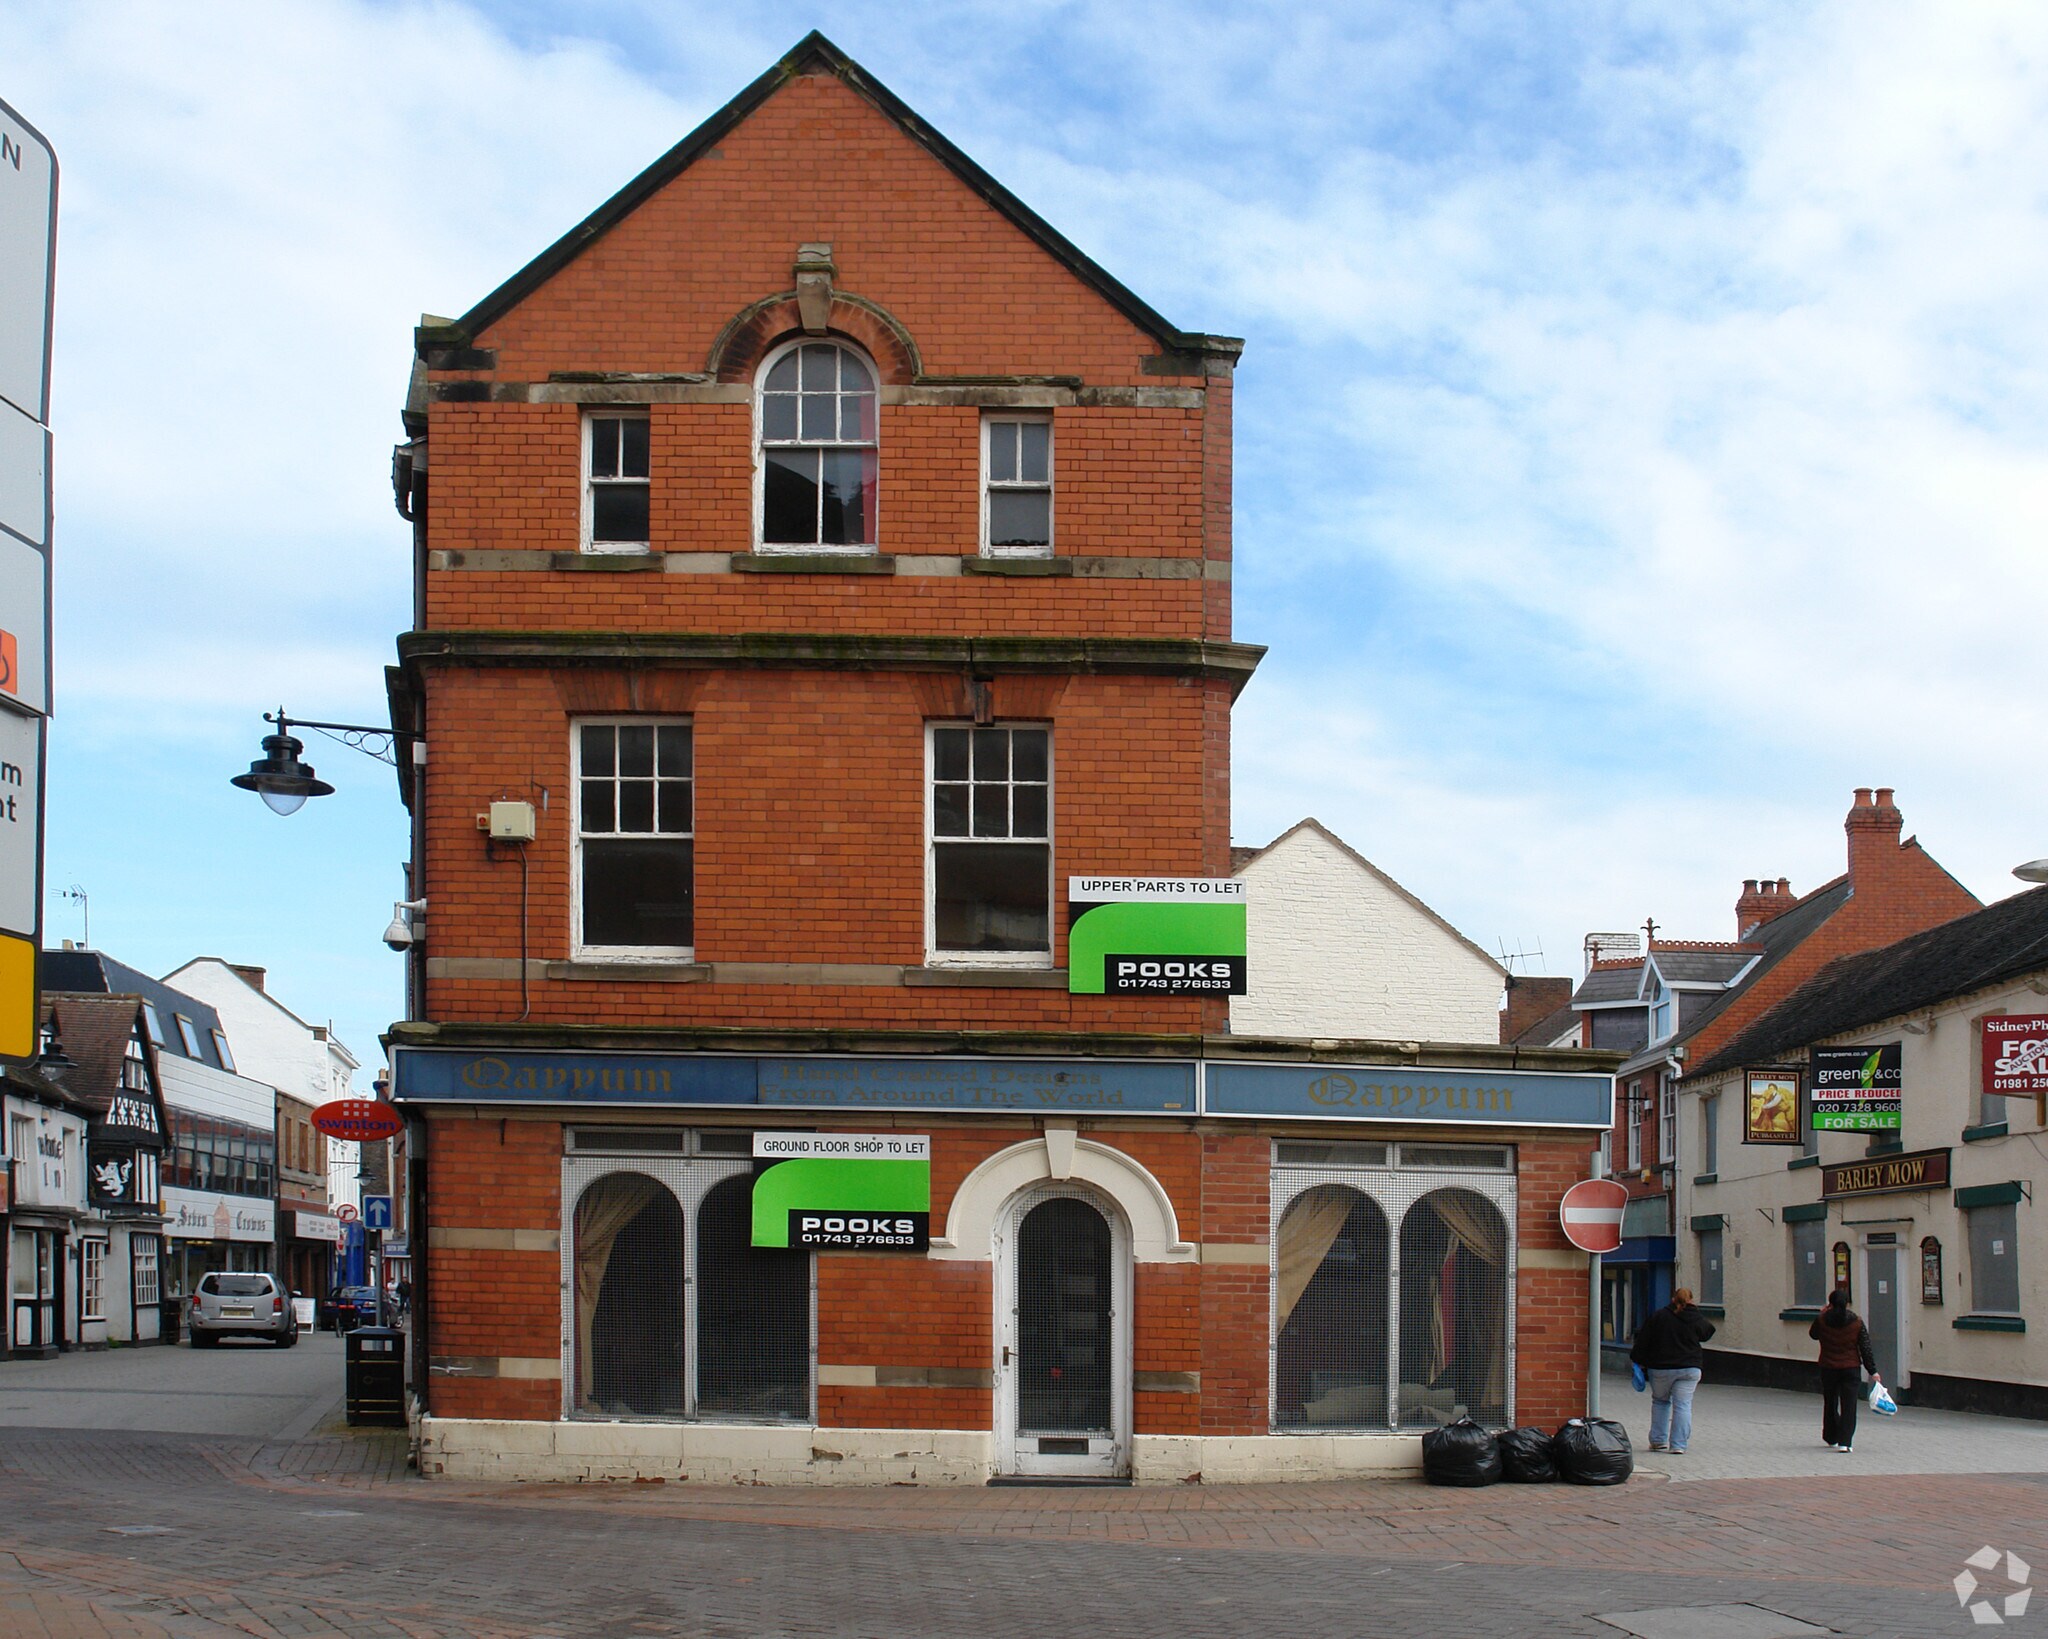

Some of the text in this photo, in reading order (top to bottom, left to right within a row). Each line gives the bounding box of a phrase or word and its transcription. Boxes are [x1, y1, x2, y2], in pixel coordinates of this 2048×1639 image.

[1081, 880, 1243, 894] UPPER PARTS TO LET
[1118, 962, 1231, 978] POOKS
[1118, 979, 1231, 989] 01743 276633
[782, 1065, 1101, 1087] Hand Crafted Designs
[1818, 1069, 1871, 1083] greene
[1994, 1079, 2027, 1089] 01981
[759, 1084, 1124, 1104] From Around The World
[1308, 1073, 1516, 1115] Qayyum
[1818, 1089, 1850, 1099] PRICE
[1818, 1103, 1840, 1112] 020
[1843, 1103, 1871, 1112] 7328
[318, 1118, 396, 1131] swinton
[1824, 1117, 1897, 1128] FOR SALE
[763, 1140, 925, 1154] GROUND FLOOR SHOP TO LET
[1837, 1159, 1926, 1191] BARLEY MOW
[801, 1217, 915, 1234] POOKS
[801, 1234, 915, 1245] 01743 276633
